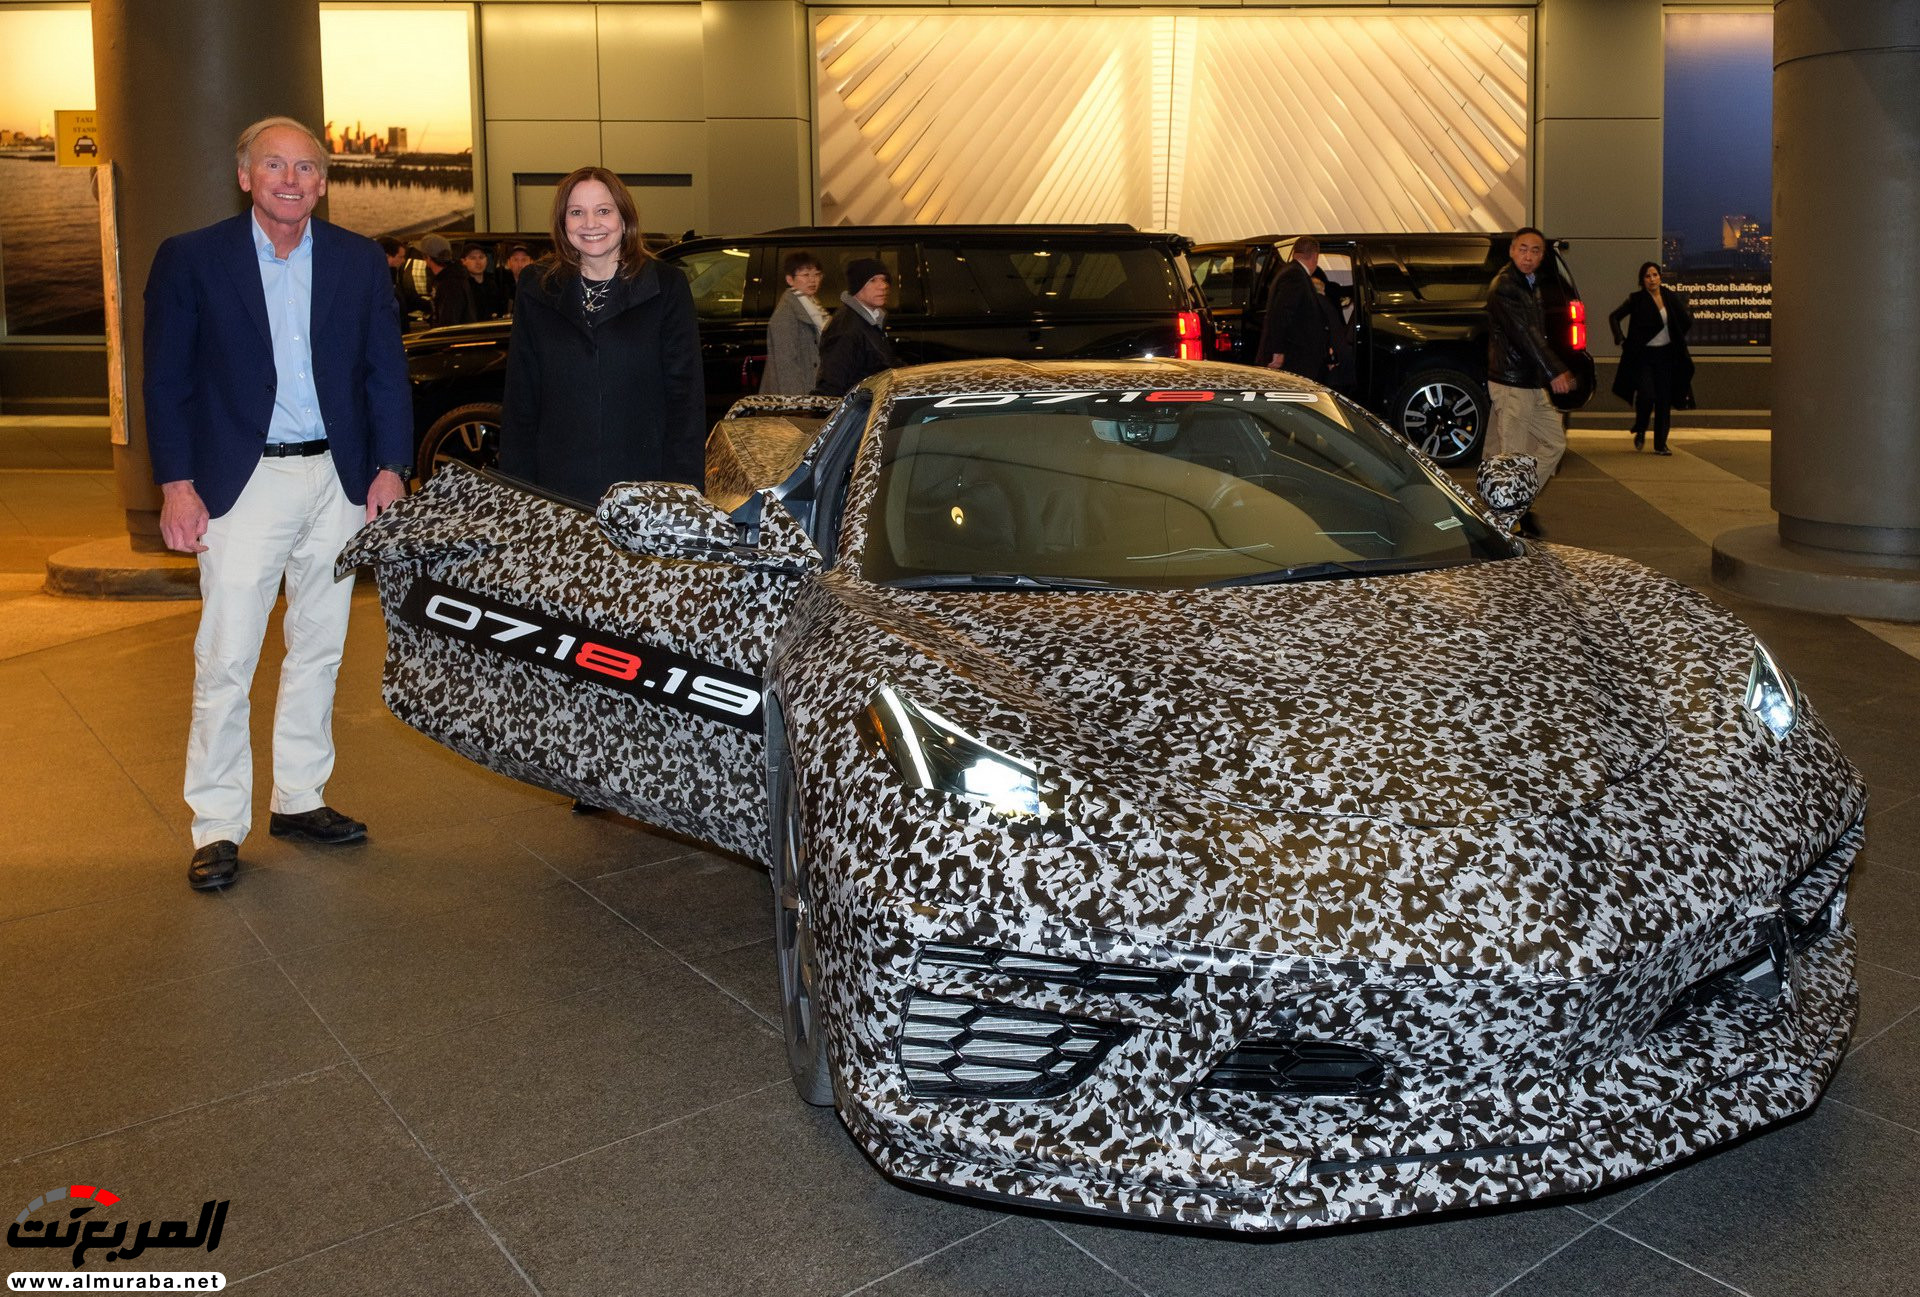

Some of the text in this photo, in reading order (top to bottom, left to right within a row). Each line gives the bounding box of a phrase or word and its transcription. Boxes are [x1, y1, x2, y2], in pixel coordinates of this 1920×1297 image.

[1677, 283, 1706, 293] Empire
[1707, 283, 1728, 292] State
[1730, 283, 1762, 293] Building
[1720, 297, 1740, 305] from
[1693, 311, 1715, 319] while
[1721, 311, 1749, 321] joyous
[933, 391, 1319, 408] 07.18.19
[425, 594, 761, 716] 07.18.19
